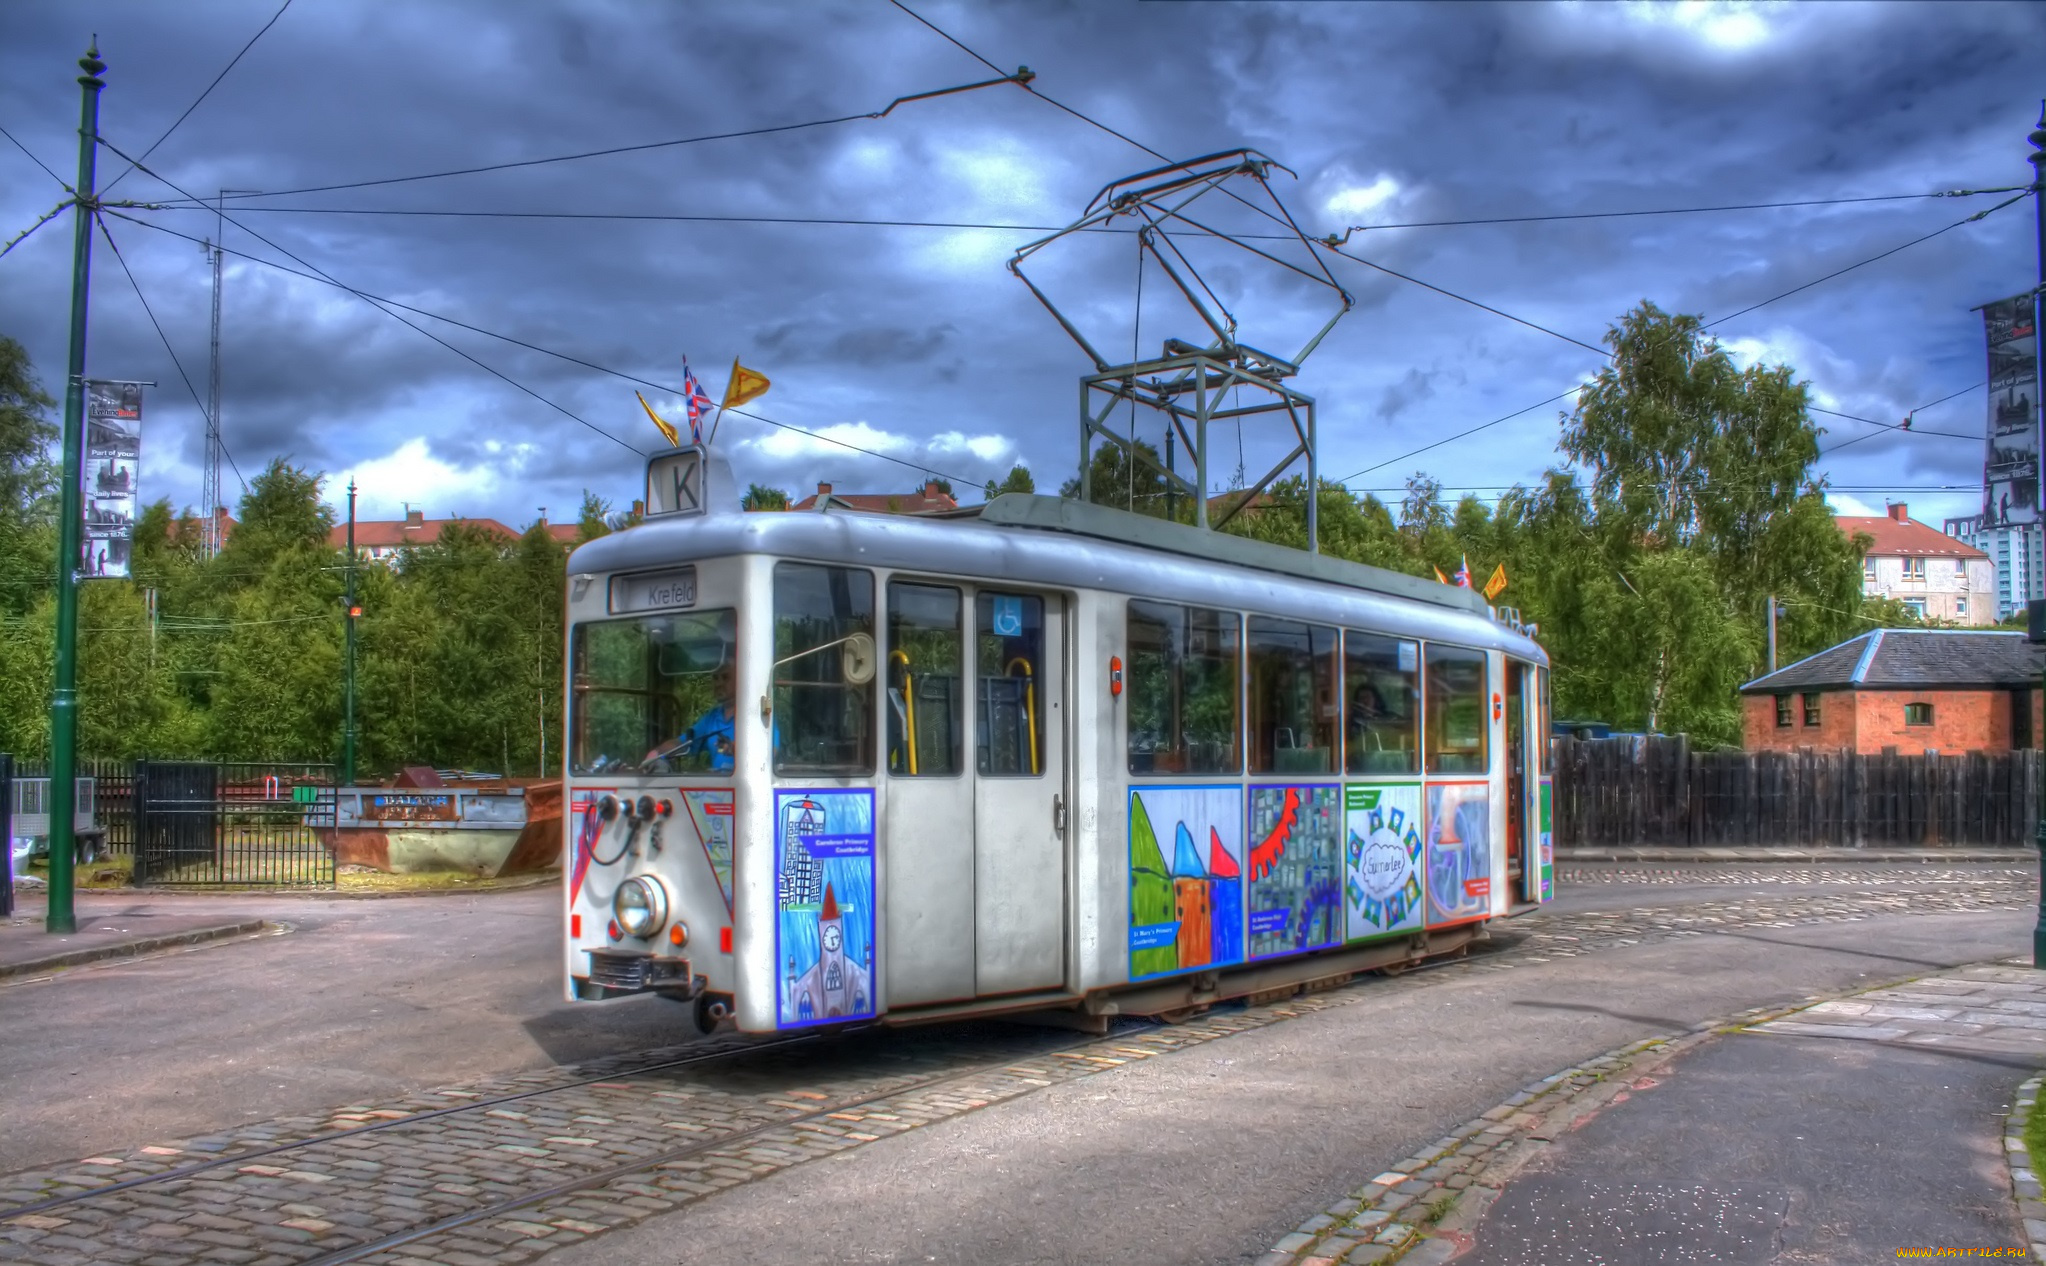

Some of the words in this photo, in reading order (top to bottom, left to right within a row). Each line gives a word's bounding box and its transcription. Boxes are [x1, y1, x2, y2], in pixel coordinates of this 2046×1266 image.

[2006, 377, 2015, 385] of
[2015, 374, 2033, 384] your
[673, 462, 698, 511] K
[93, 490, 110, 498] daily
[648, 582, 695, 606] Krefeld
[844, 838, 869, 846] Primary
